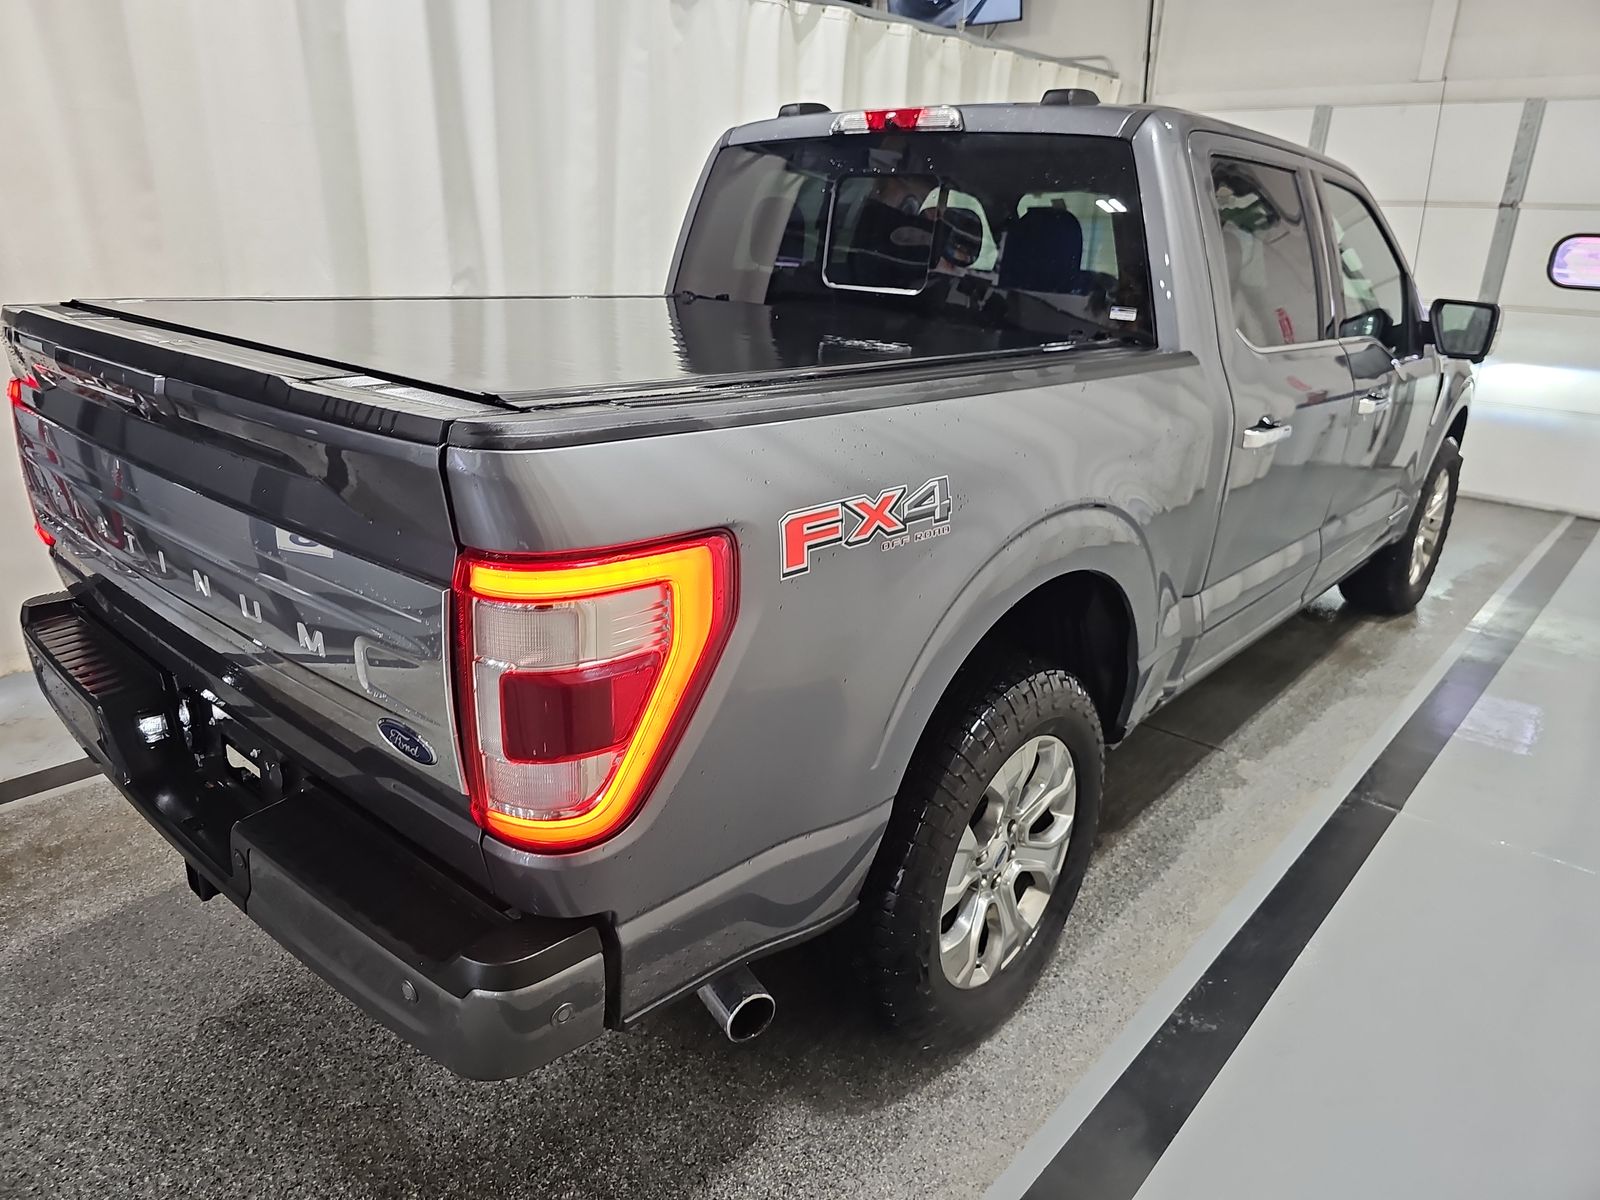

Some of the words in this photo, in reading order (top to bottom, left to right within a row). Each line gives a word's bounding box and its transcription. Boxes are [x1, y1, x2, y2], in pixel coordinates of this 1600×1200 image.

[778, 475, 952, 581] FX4
[880, 535, 911, 552] OFF
[914, 524, 951, 543] ROAD
